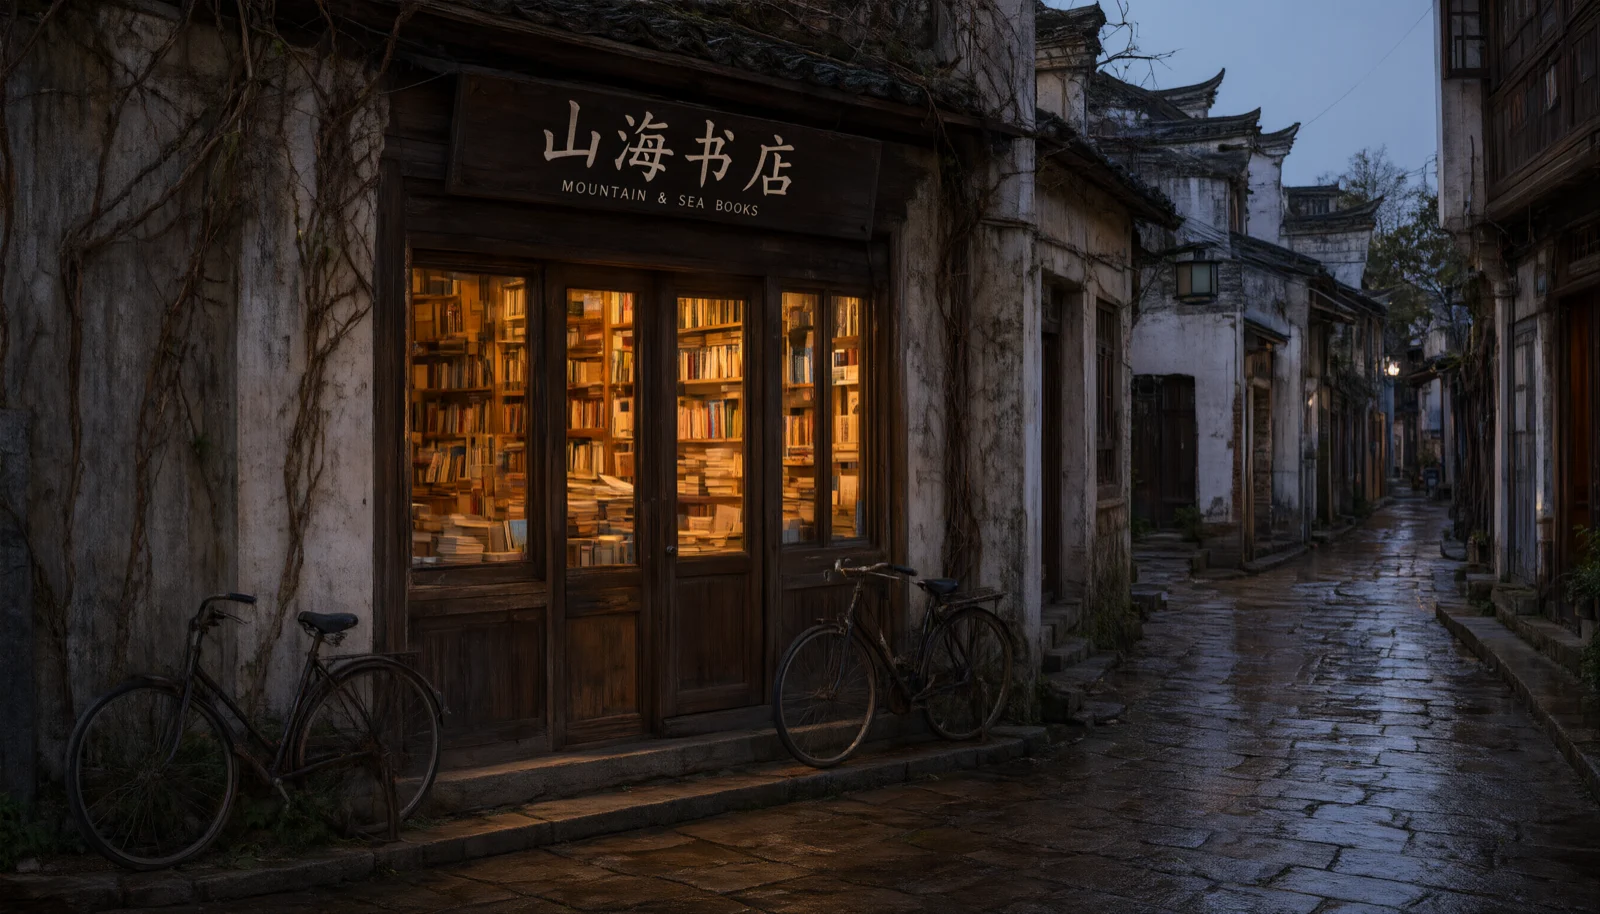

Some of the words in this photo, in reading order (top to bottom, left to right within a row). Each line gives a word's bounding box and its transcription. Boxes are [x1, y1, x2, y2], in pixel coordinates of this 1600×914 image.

[543, 100, 795, 196] 山海书店
[561, 179, 647, 202] MOUNTAIN
[657, 192, 667, 204] &
[678, 194, 705, 209] SEA
[715, 200, 759, 217] BOOKS
